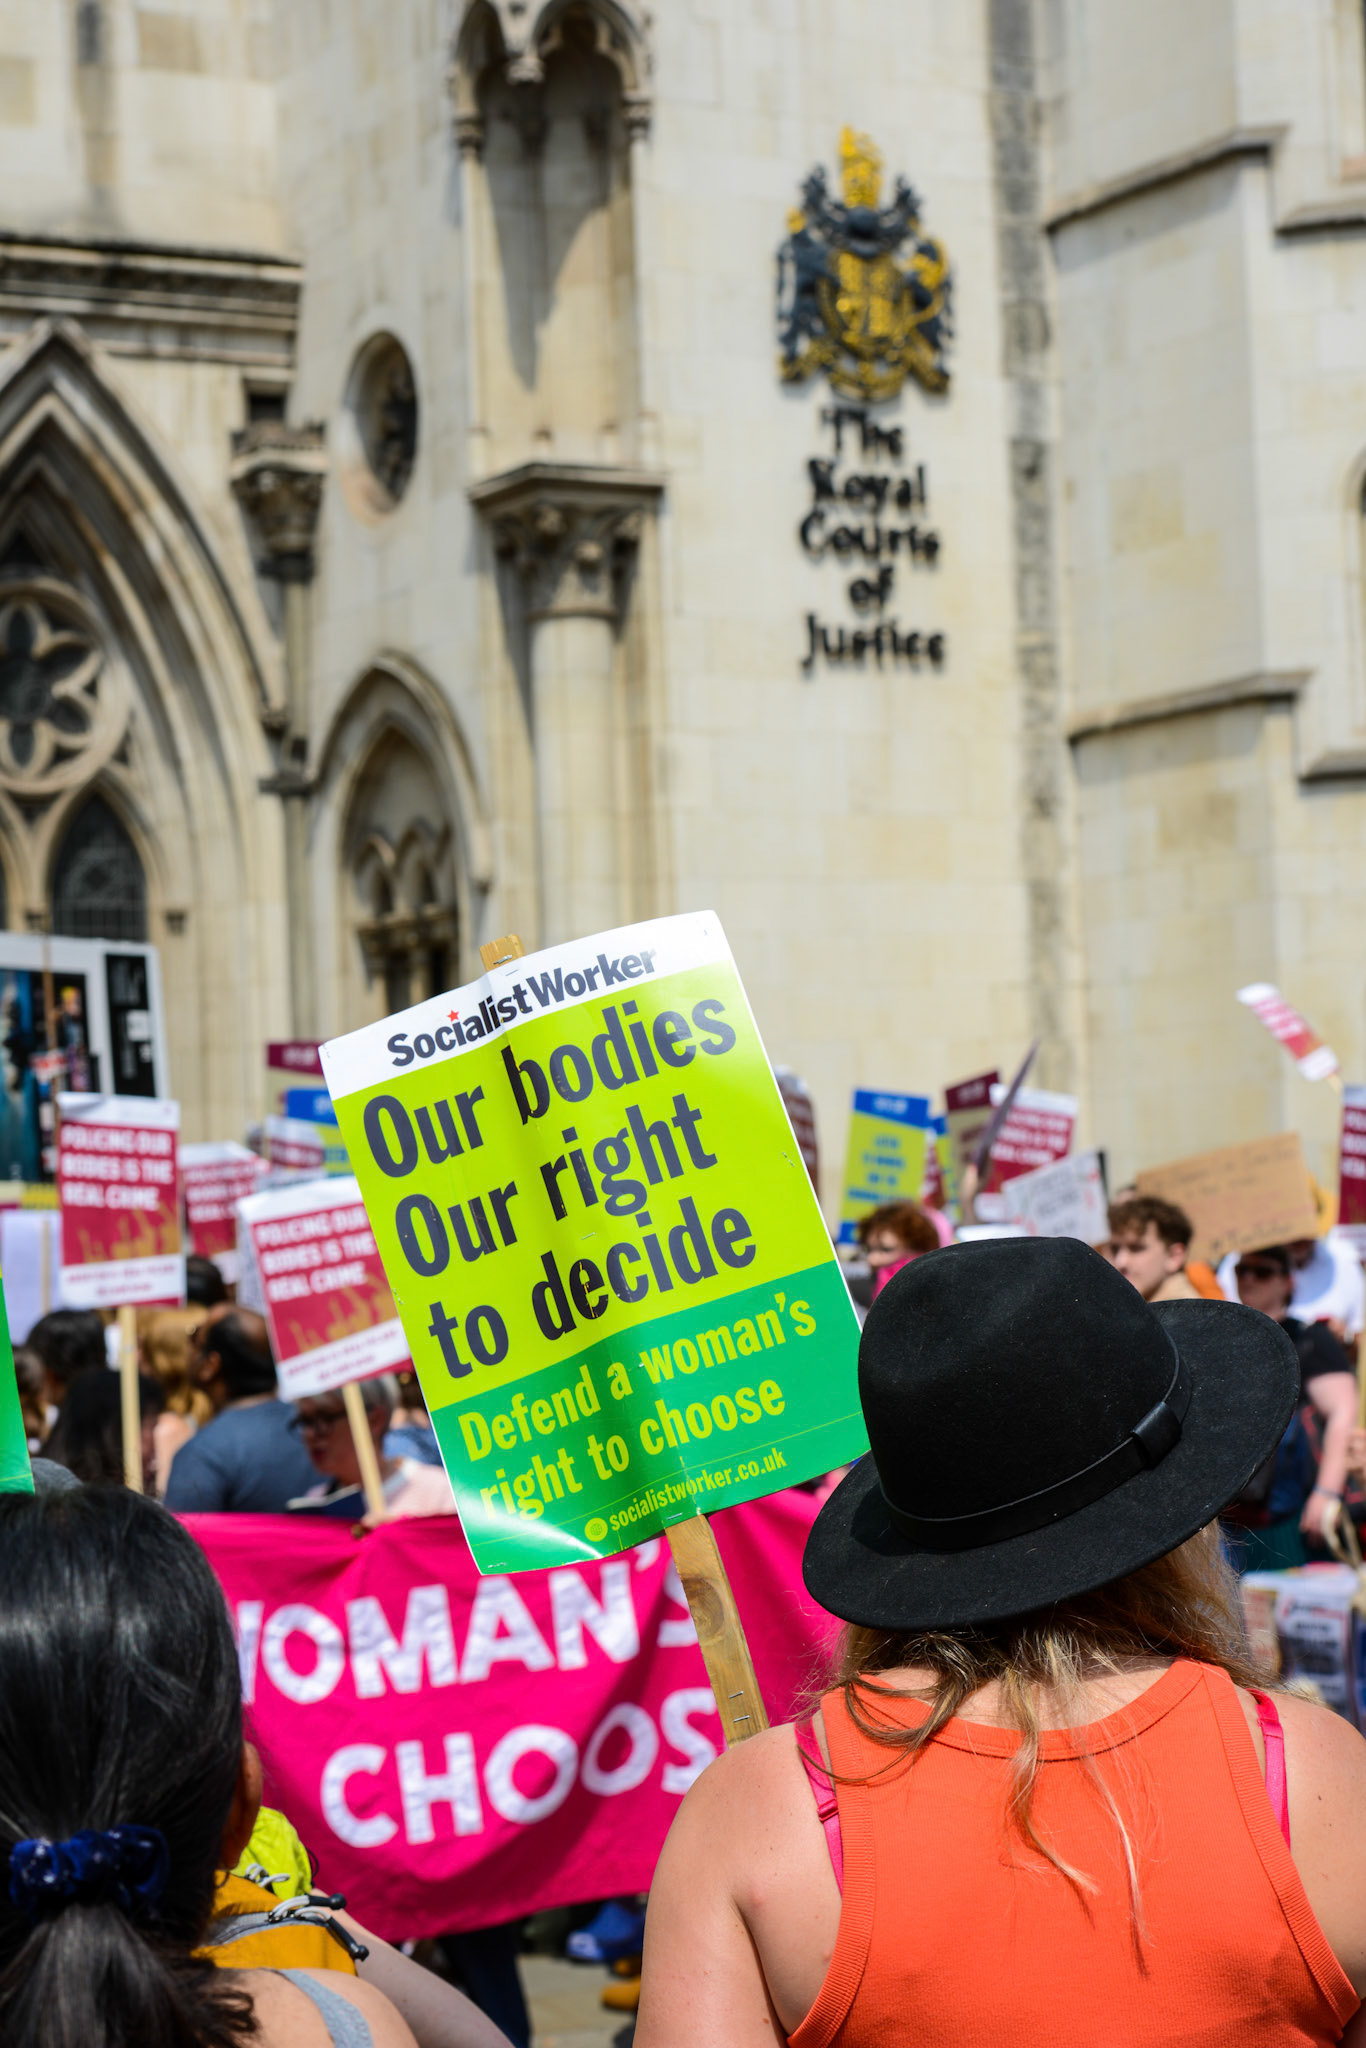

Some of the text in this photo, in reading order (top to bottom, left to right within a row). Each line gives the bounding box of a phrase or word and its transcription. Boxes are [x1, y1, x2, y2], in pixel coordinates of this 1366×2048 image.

[820, 409, 902, 456] The
[808, 459, 926, 513] Royal
[799, 510, 939, 561] Courts
[850, 566, 894, 606] of
[801, 613, 944, 670] Justice
[363, 998, 737, 1178] Our bodies
[394, 1180, 519, 1277] Our
[540, 1093, 717, 1221] right
[428, 1302, 509, 1379] to
[531, 1197, 757, 1341] decide
[458, 1292, 817, 1462] Defend a woman's
[479, 1378, 786, 1522] right to choose
[609, 1450, 787, 1531] socialistworker.co.uk
